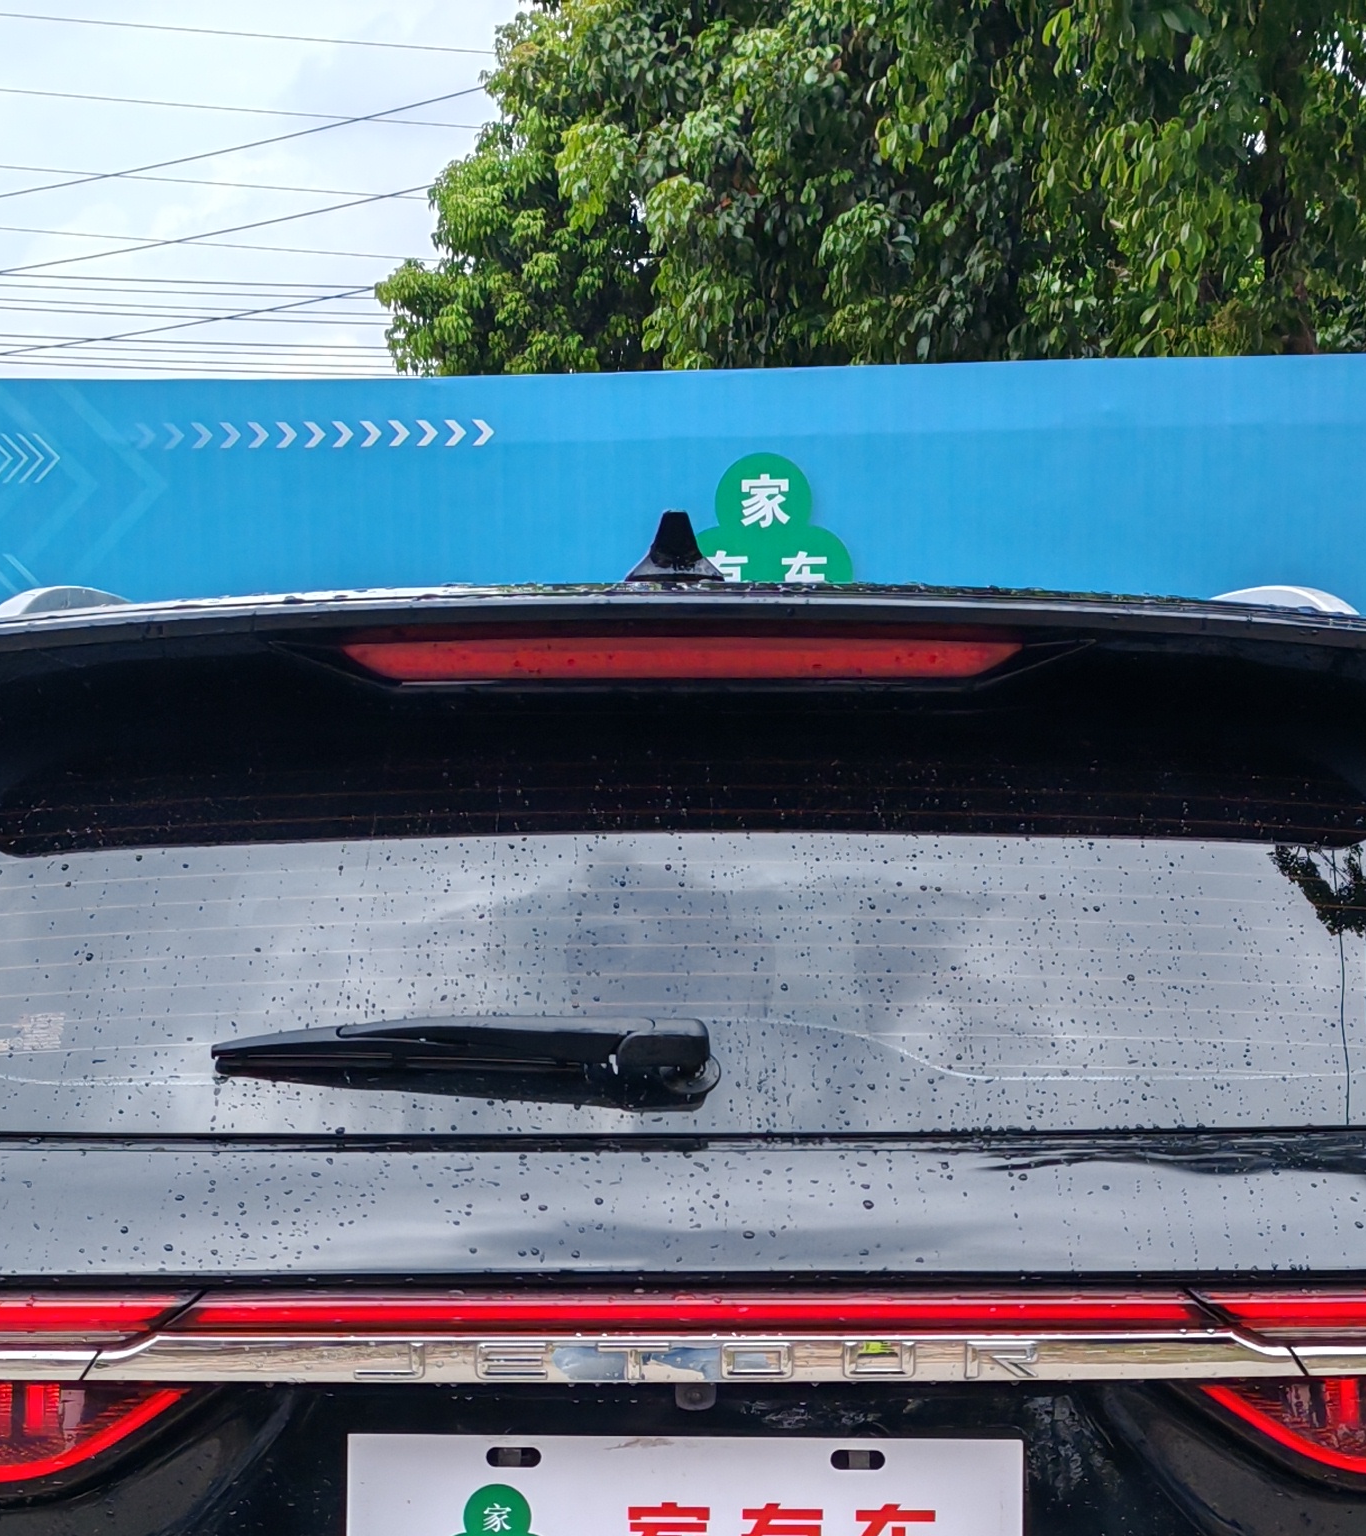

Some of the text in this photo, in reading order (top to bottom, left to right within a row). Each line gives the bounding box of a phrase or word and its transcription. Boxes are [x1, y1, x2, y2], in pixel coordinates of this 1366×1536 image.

[740, 473, 791, 528] 家
[353, 1341, 1038, 1380] JETOUR
[482, 1502, 512, 1533] 家
